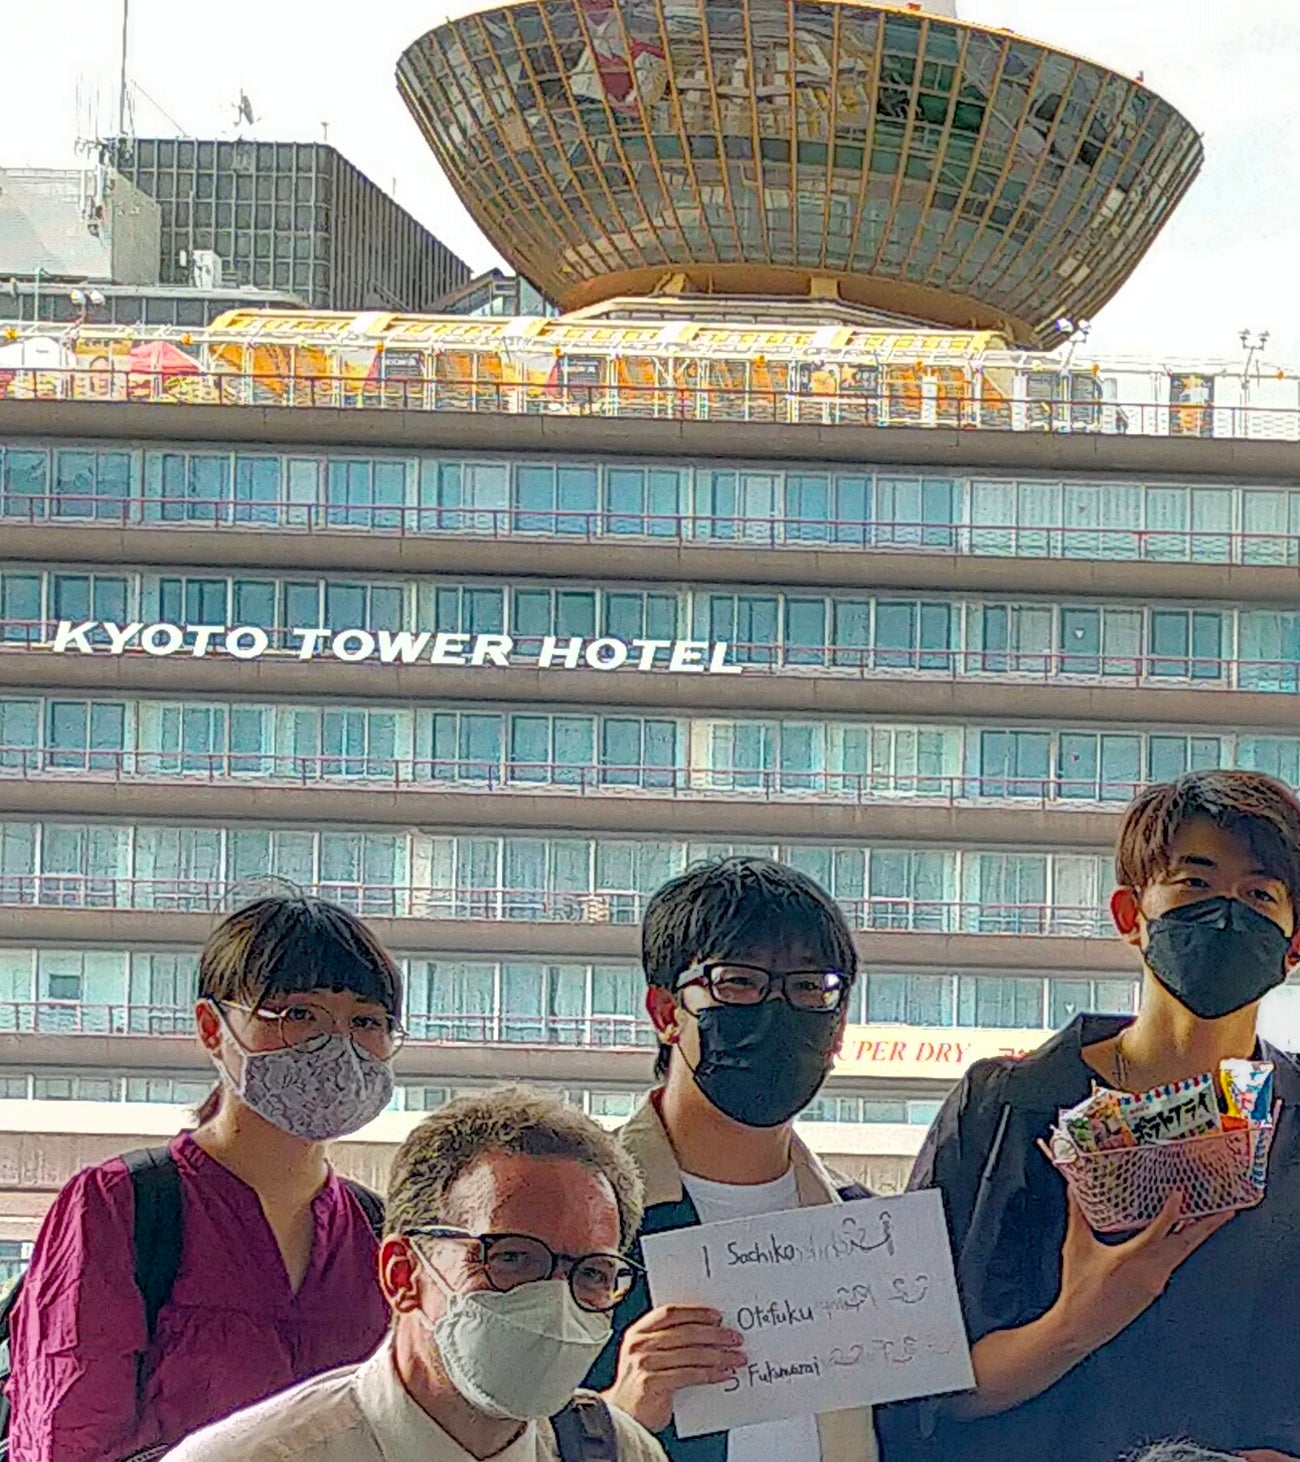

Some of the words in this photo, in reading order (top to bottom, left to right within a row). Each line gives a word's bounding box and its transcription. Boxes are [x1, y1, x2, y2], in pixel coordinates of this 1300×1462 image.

[52, 620, 269, 660] KYOTO
[292, 627, 513, 666] TOWER
[538, 636, 743, 674] HOTEL
[835, 1040, 904, 1061] UPER
[915, 1042, 971, 1063] DRY
